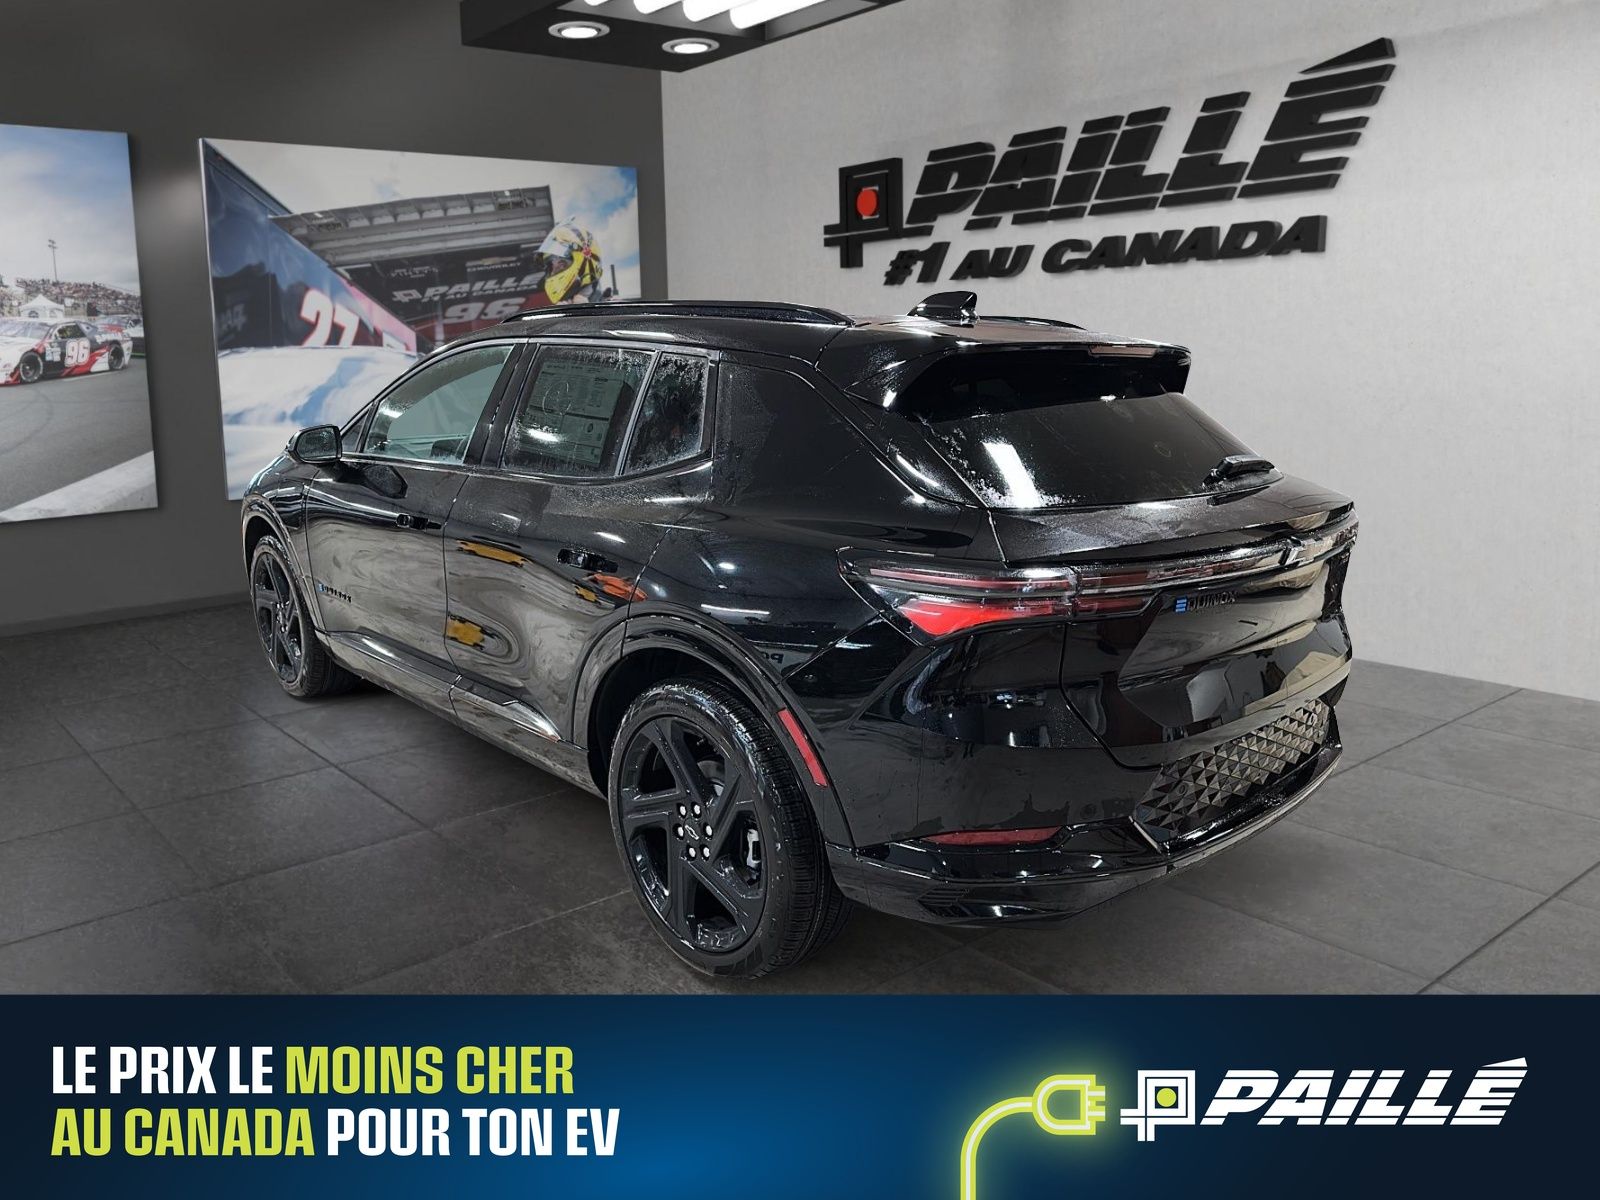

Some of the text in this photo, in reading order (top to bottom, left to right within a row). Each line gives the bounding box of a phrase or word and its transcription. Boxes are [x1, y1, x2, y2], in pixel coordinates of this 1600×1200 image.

[905, 37, 1396, 230] PAILLÉ
[884, 214, 1328, 286] #1 AU CANADA
[300, 288, 360, 348] 27
[441, 297, 526, 325] 96
[64, 338, 92, 368] 96
